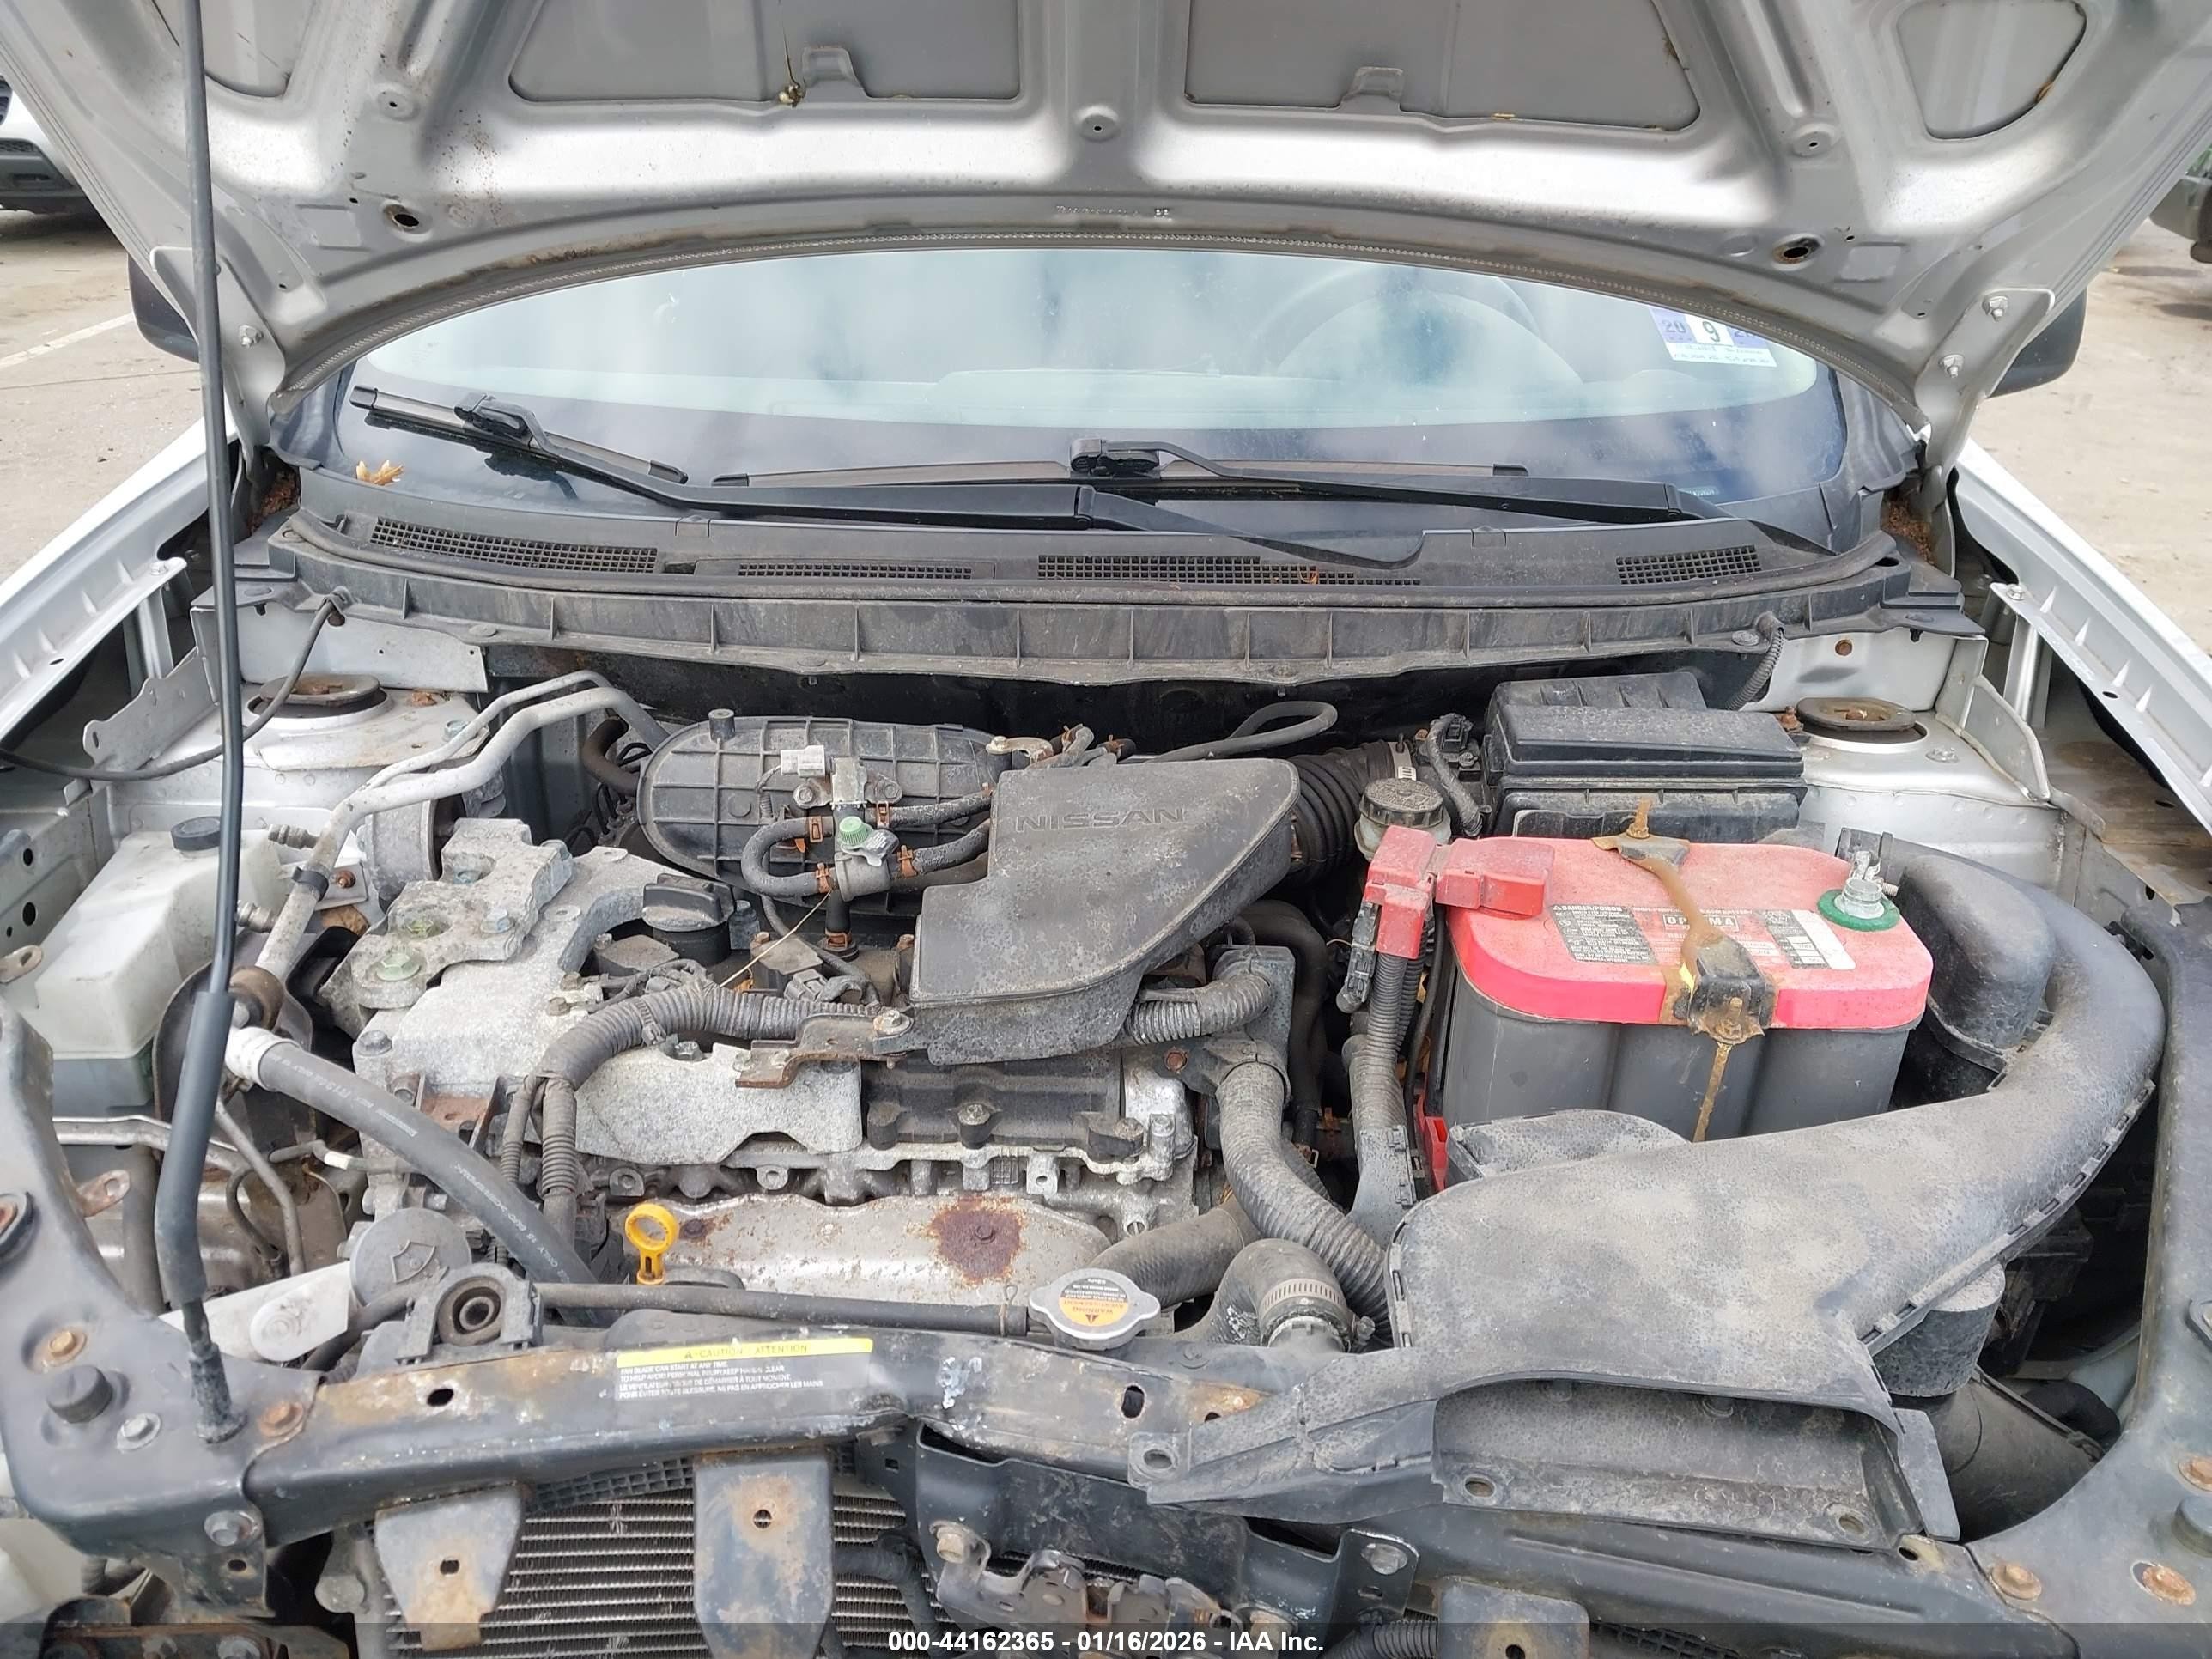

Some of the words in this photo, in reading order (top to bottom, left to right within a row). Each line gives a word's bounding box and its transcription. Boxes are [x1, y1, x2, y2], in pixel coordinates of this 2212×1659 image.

[1702, 320, 1721, 343] 9
[1016, 808, 1185, 832] NISSAN
[700, 1347, 742, 1358] CAUTION
[756, 1345, 807, 1354] ATTENTION
